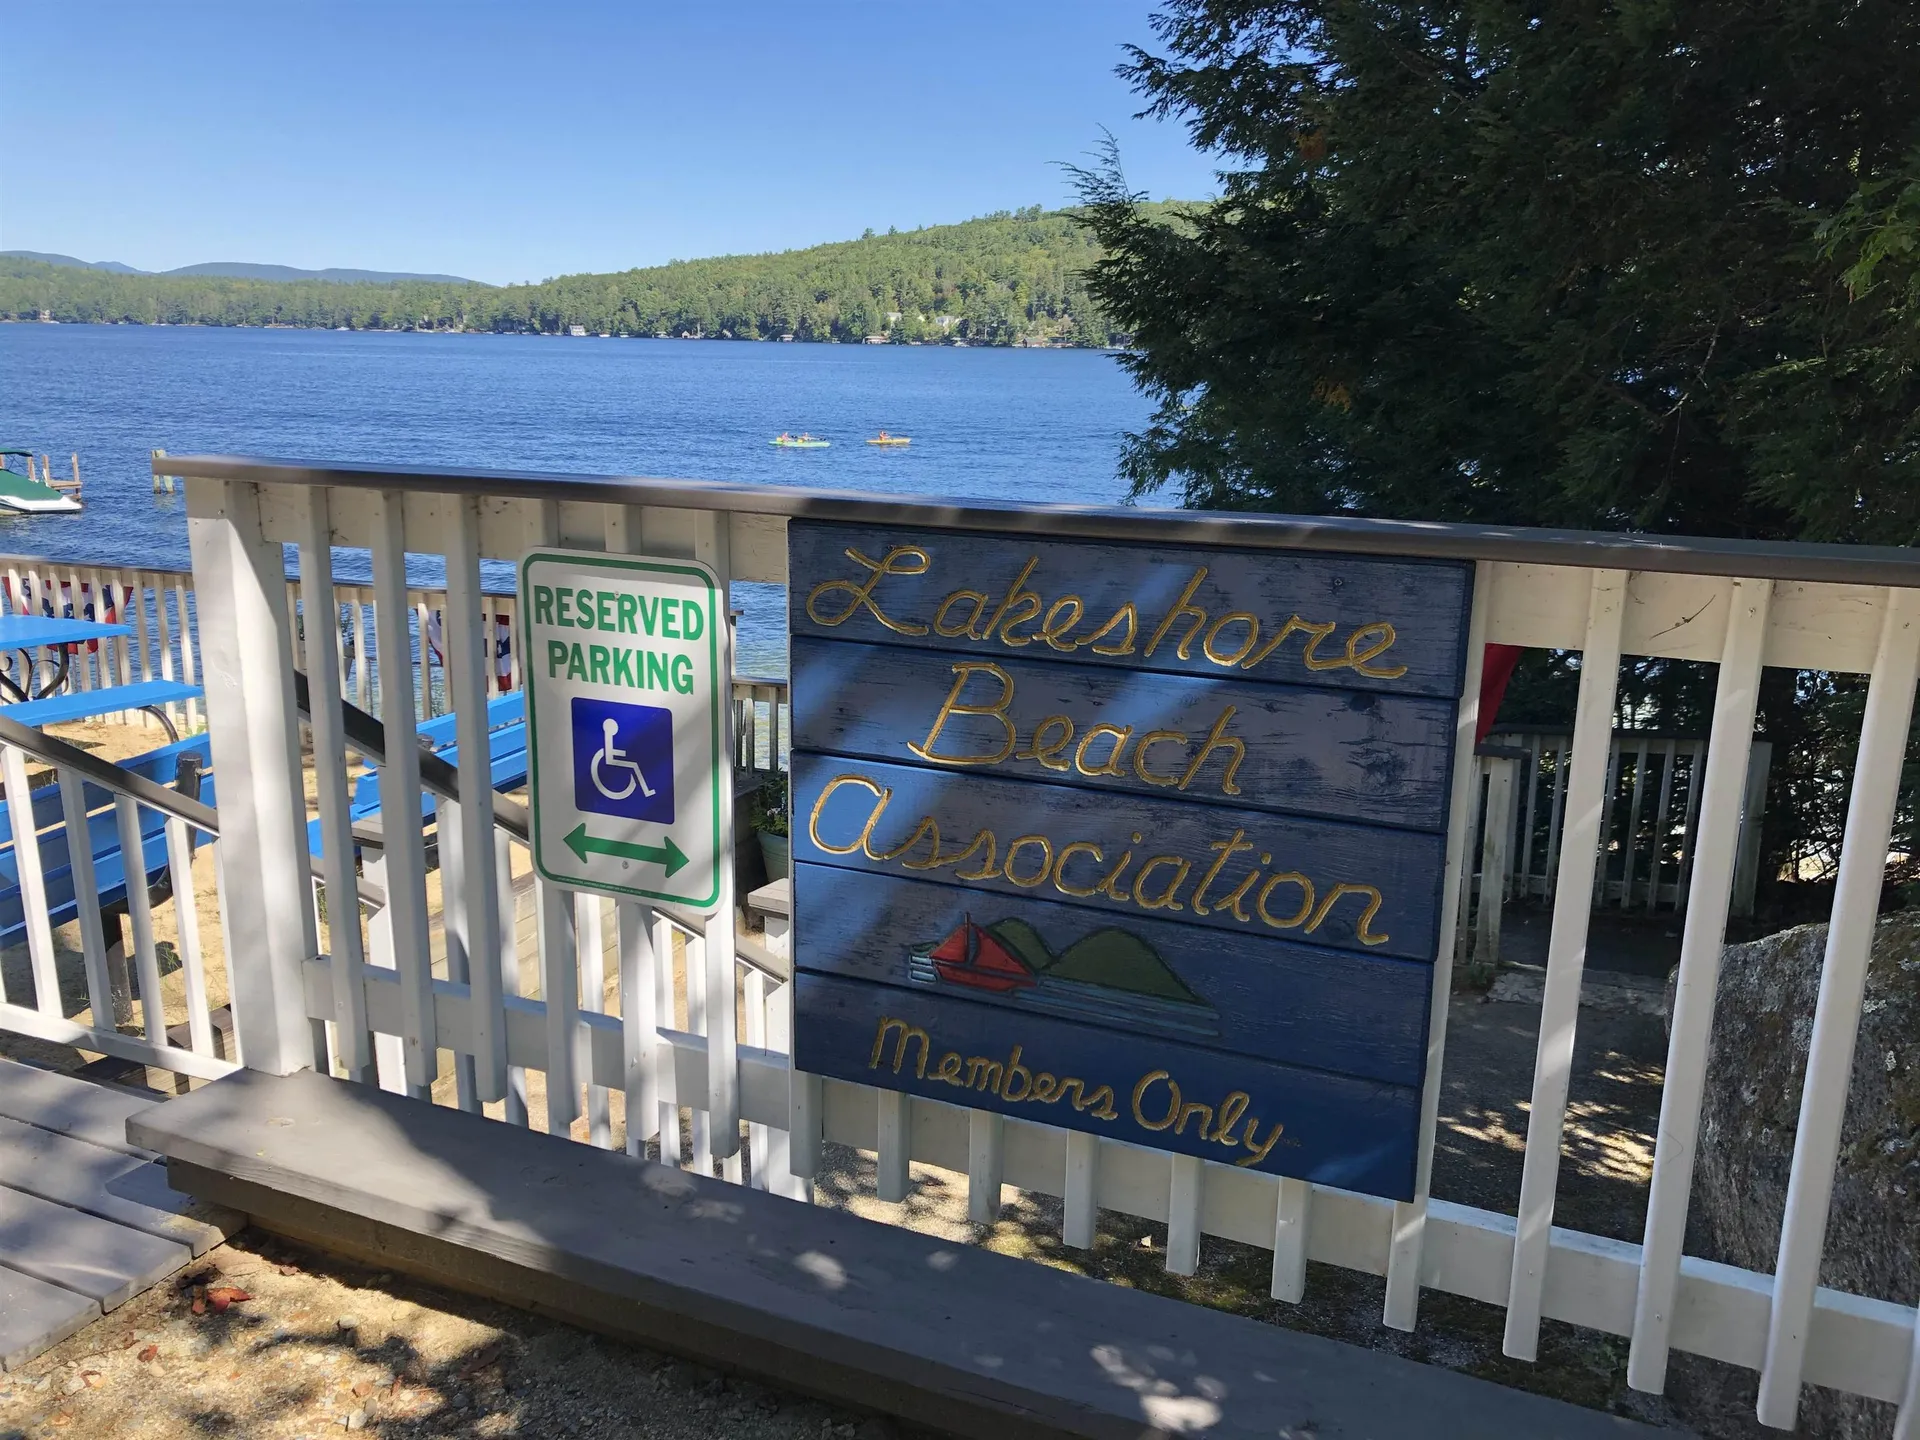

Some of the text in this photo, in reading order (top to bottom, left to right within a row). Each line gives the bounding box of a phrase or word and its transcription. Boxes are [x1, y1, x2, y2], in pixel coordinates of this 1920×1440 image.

[533, 585, 705, 641] RESERVED
[547, 640, 694, 695] PARKING
[806, 545, 1408, 679] Lakeshore
[906, 661, 1246, 795] Beach
[808, 774, 1390, 946] Association
[868, 1016, 1284, 1166] Members Only
